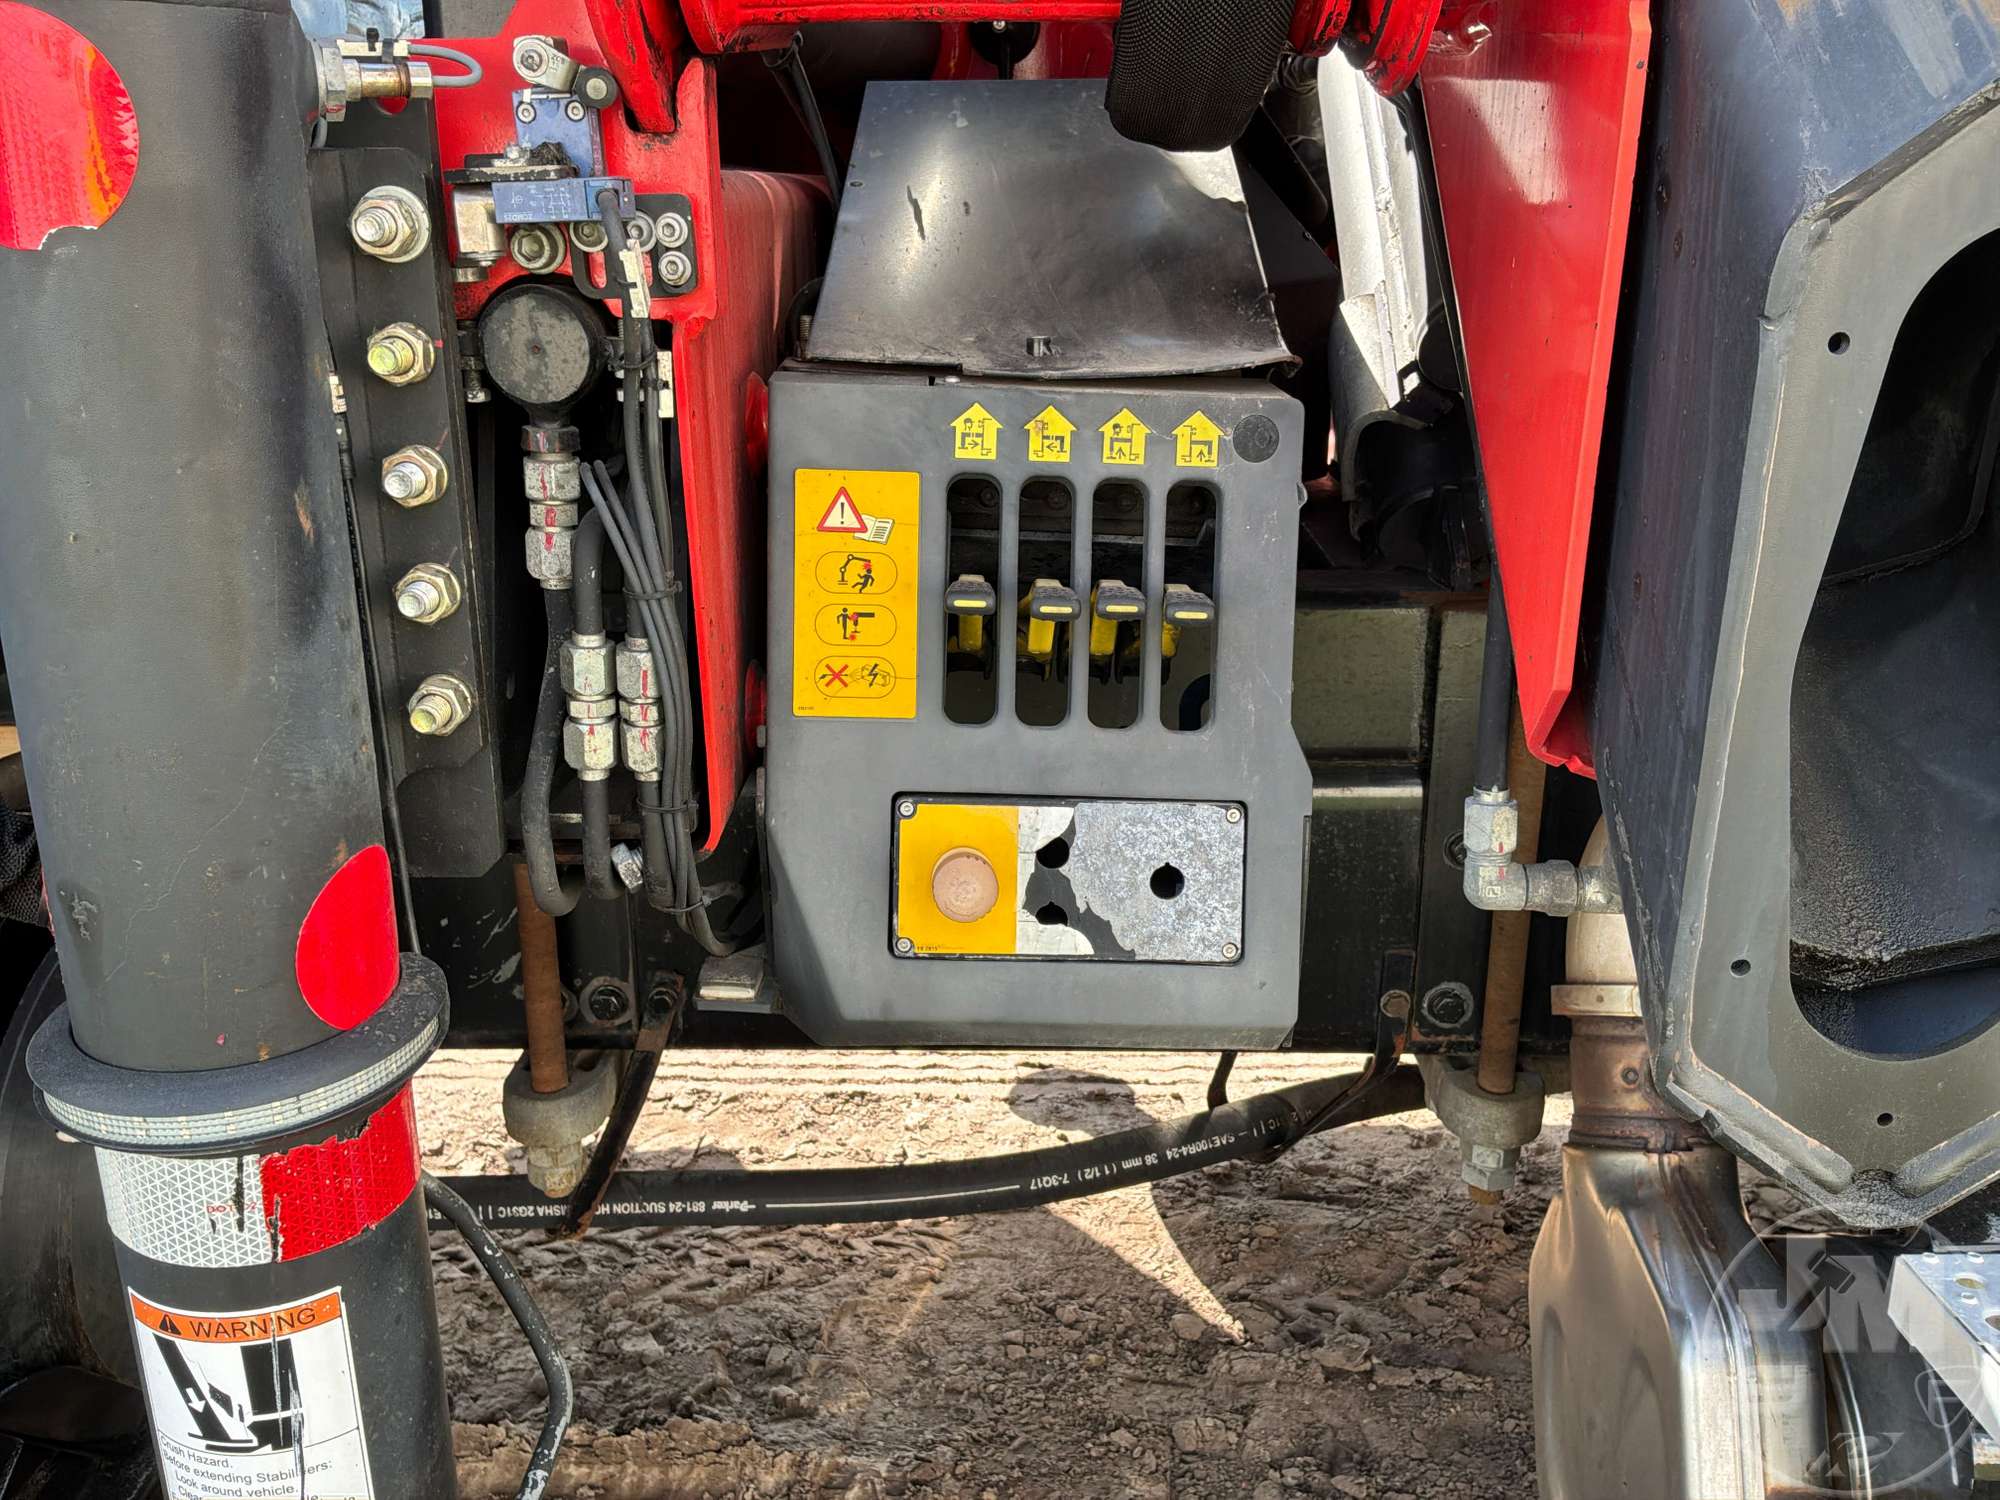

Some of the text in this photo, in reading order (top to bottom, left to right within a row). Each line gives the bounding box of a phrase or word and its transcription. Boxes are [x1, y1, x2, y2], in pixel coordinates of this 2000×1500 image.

[1166, 1133, 1235, 1160] SAE100R4-24
[1121, 1156, 1142, 1169] mm
[1145, 1153, 1158, 1166] 38
[1030, 1172, 1070, 1190] 7-3Q17
[613, 1202, 666, 1214] SUCTION
[711, 1201, 752, 1212] Parker
[189, 1308, 316, 1338] WARNING
[161, 1435, 233, 1469] Crush Hazard.
[163, 1451, 333, 1485] Before extending Stabiliers:
[175, 1470, 199, 1489] Look
[201, 1484, 243, 1498] around
[246, 1485, 299, 1498] vehicle.
